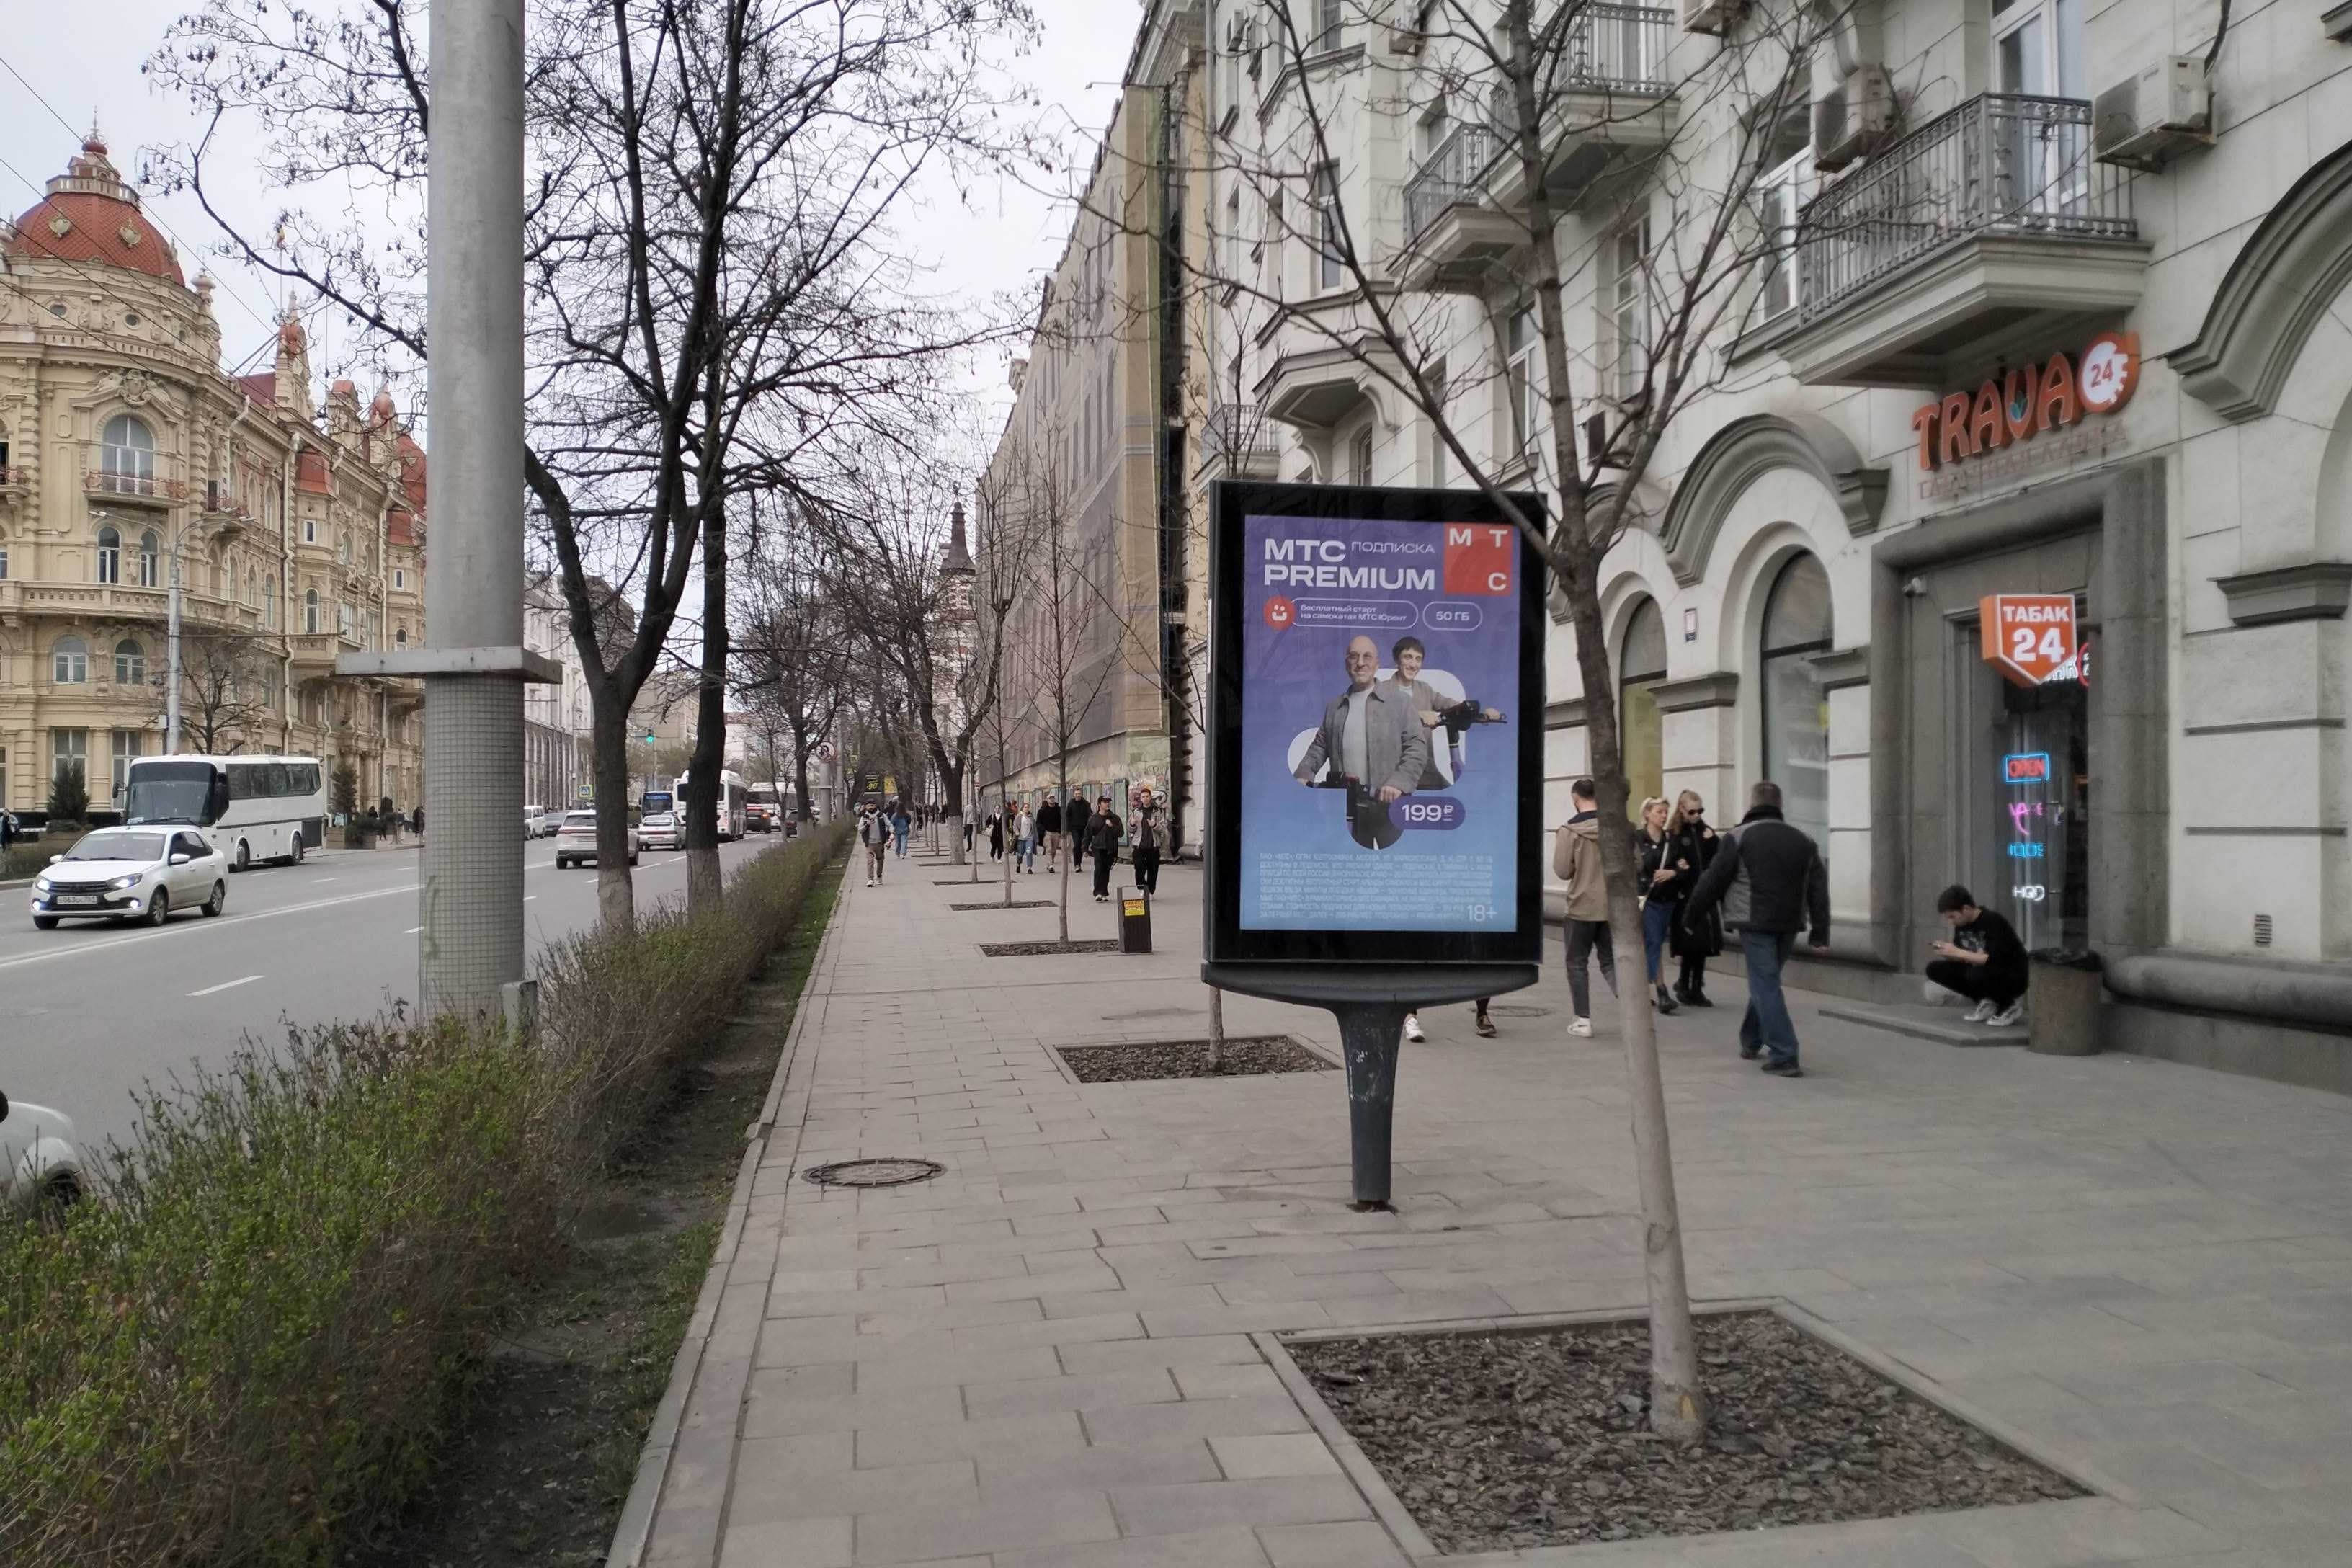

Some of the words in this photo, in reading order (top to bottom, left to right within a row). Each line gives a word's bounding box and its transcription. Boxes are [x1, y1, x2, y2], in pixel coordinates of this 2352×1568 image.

[1912, 352, 2073, 470] TRAVA
[2091, 359, 2113, 388] 24
[1449, 527, 1471, 546] М
[1489, 530, 1508, 548] Т
[1264, 538, 1346, 563] МТС
[1351, 541, 1435, 554] ПОДПИСКА
[1263, 564, 1436, 591] PREMIUM
[1487, 572, 1507, 591] С
[1301, 604, 1351, 612] бесплатный
[1435, 612, 1452, 621] 50
[1454, 612, 1470, 621] ГБ
[2003, 606, 2070, 622] ТАБАК
[1378, 614, 1407, 623] Юрент
[2013, 628, 2066, 663] 24
[2009, 760, 2044, 777] OPEN
[2012, 886, 2045, 901] HQD
[1467, 904, 1497, 922] 18+
